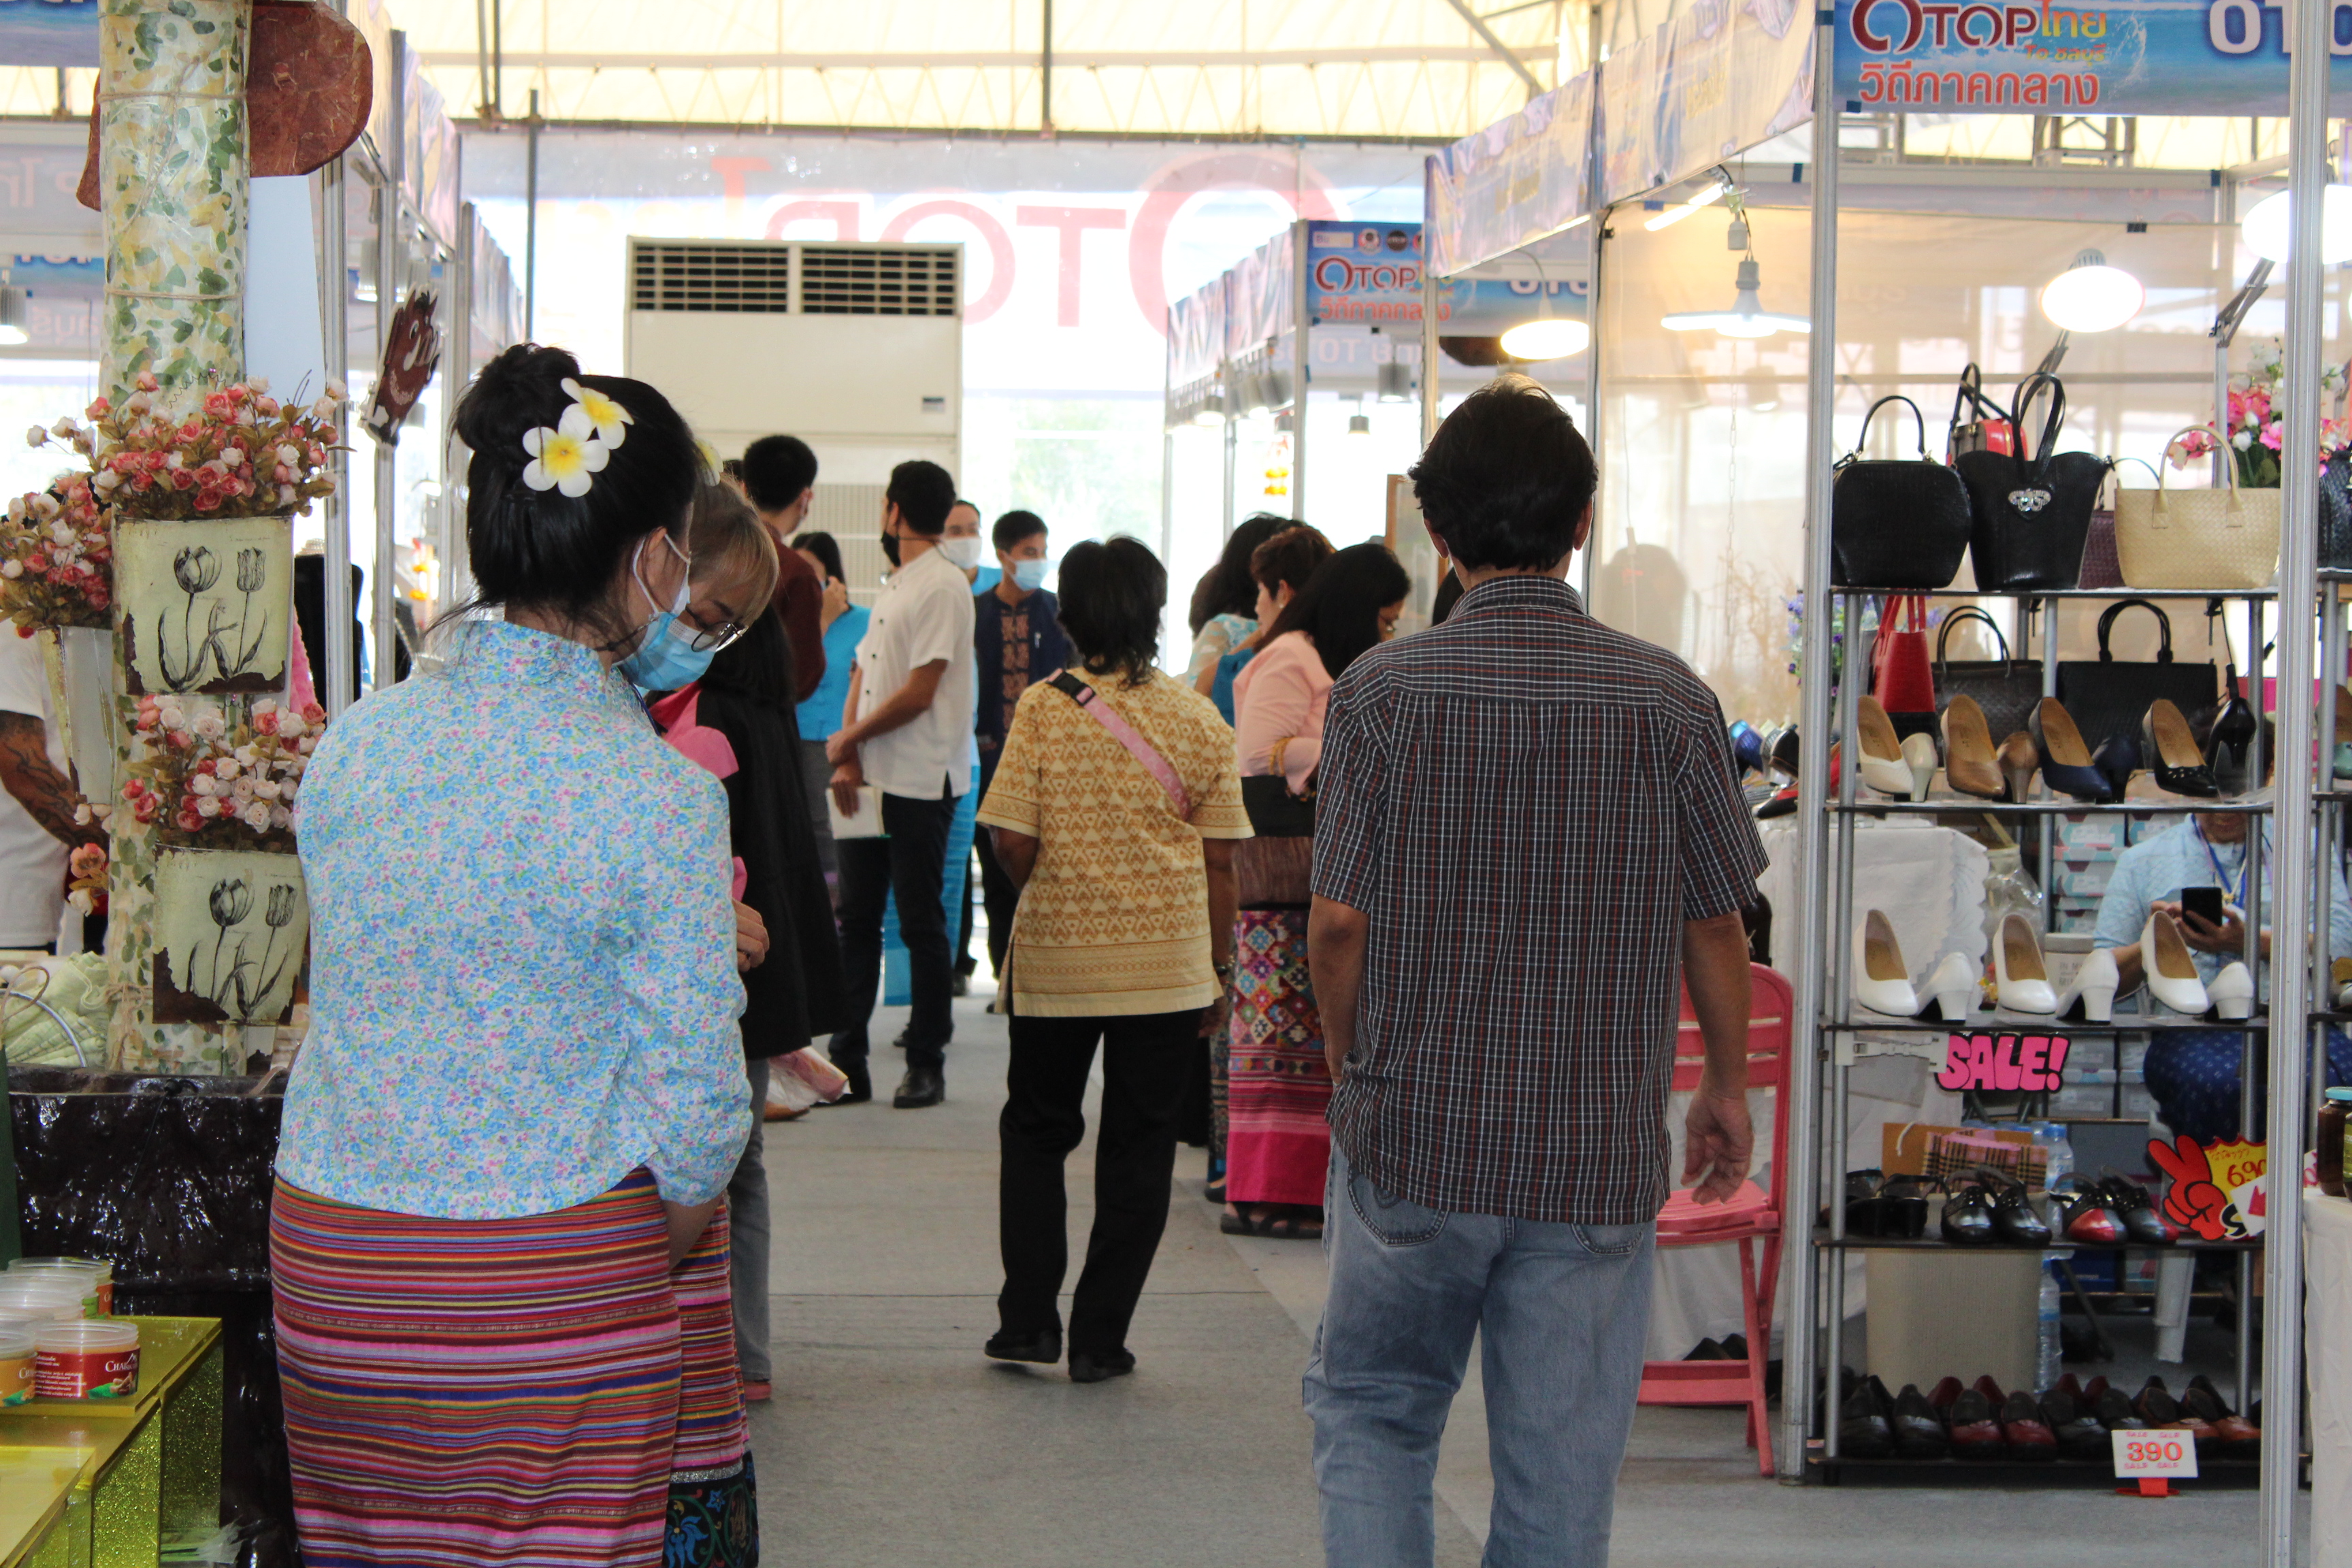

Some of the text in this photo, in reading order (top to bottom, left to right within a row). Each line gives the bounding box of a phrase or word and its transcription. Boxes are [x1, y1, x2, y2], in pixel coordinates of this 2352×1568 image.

[1852, 0, 2037, 52] OTOP
[1859, 60, 2099, 105] วิถีภาคกลาง
[1314, 256, 1418, 292] OTOP
[1318, 297, 1452, 322] วิถีภาคกลง
[1936, 1033, 2071, 1093] SALE!
[2127, 1441, 2183, 1462] 390
